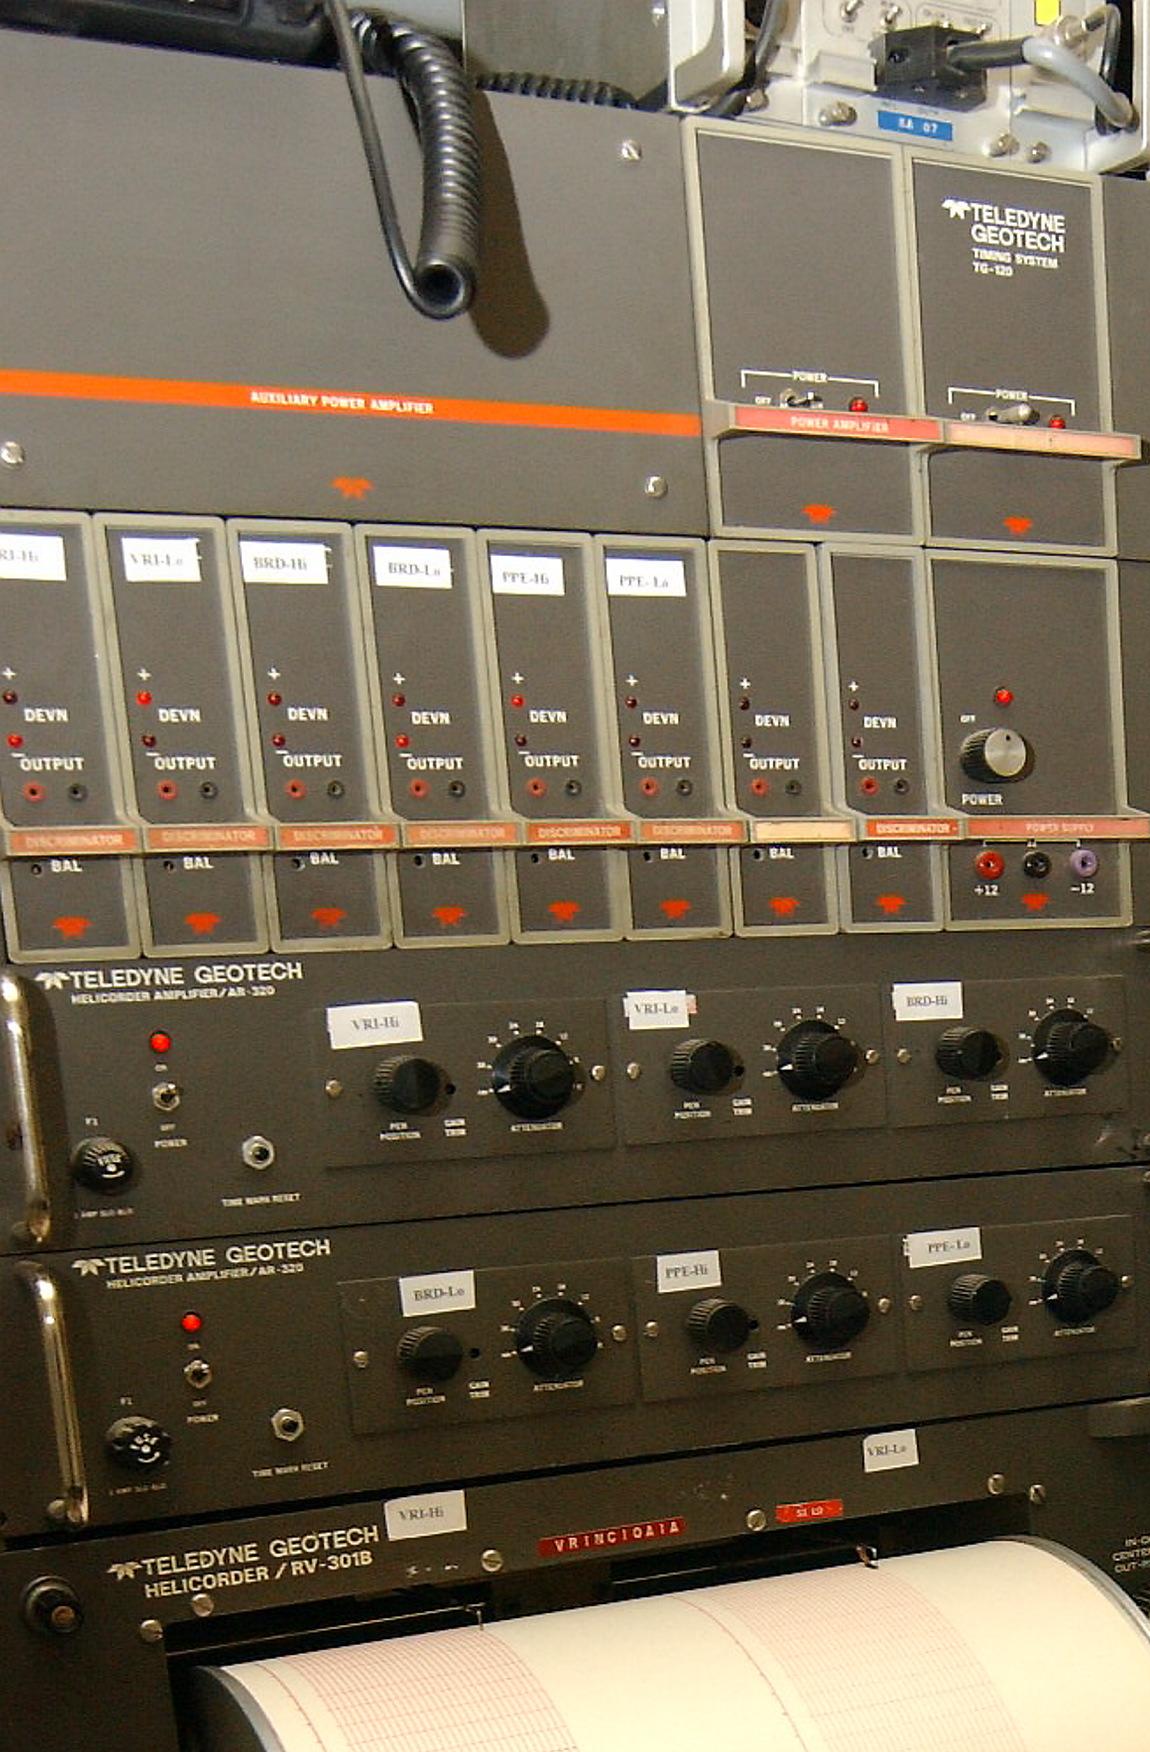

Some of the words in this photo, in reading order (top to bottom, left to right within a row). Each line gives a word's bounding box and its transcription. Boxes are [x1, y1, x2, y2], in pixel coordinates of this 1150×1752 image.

[970, 202, 1066, 234] TELEDYNE
[970, 223, 1065, 253] GEOTECH
[972, 248, 1012, 263] TIMING
[1014, 253, 1058, 269] SYSTEM
[250, 391, 319, 407] AUXILIARY
[321, 395, 365, 411] POWER
[370, 398, 434, 415] AMPLIFIER
[789, 415, 830, 429] POWER
[832, 418, 890, 433] AMPLIFIER
[24, 707, 69, 723] DEVN
[158, 707, 202, 723] DEVN
[287, 706, 328, 722] DEVN
[411, 711, 451, 726] DEVN
[529, 709, 568, 724] DEVN
[642, 711, 680, 727] DEVN
[754, 714, 790, 729] DEVN
[863, 716, 897, 730] DEVN
[19, 756, 85, 772] OUTPUT
[153, 755, 217, 771] OUTPUT
[282, 753, 343, 769] OUTPUT
[406, 755, 464, 771] OUTPUT
[524, 753, 580, 769] OUTPUT
[637, 755, 692, 770] OUTPUT
[749, 756, 800, 771] OUTPUT
[858, 757, 907, 771] OUTPUT
[961, 793, 1004, 806] POWER
[876, 822, 951, 835] DISCRIMINATOR
[309, 852, 339, 866] BAL
[432, 852, 460, 866] BAL
[548, 848, 575, 862] BAL
[660, 847, 686, 861] BAL
[769, 847, 795, 860] BAL
[877, 846, 902, 859] BAL
[51, 859, 83, 873] BAL
[183, 856, 214, 870] BAL
[69, 965, 184, 990] TELEDYNE
[193, 961, 304, 985] GEOTECH
[71, 992, 151, 1005] HELICORDER
[906, 993, 948, 1008] BRD-Hi
[633, 1002, 680, 1016] VRI-Lo
[350, 1016, 400, 1031] VRI-Hi
[103, 1248, 216, 1274] TELEDYNE
[226, 1238, 331, 1264] GEOTECH
[664, 1263, 709, 1280] PPE-Hi
[106, 1273, 185, 1291] HELICORDER
[413, 1285, 466, 1302] BRD-Lo
[399, 1504, 445, 1522] VRI-Hi
[140, 1542, 259, 1577] TELEDYNE
[268, 1524, 380, 1558] GEOTECH
[144, 1564, 270, 1599] HELICORDER
[290, 1549, 374, 1577] RV-301B
